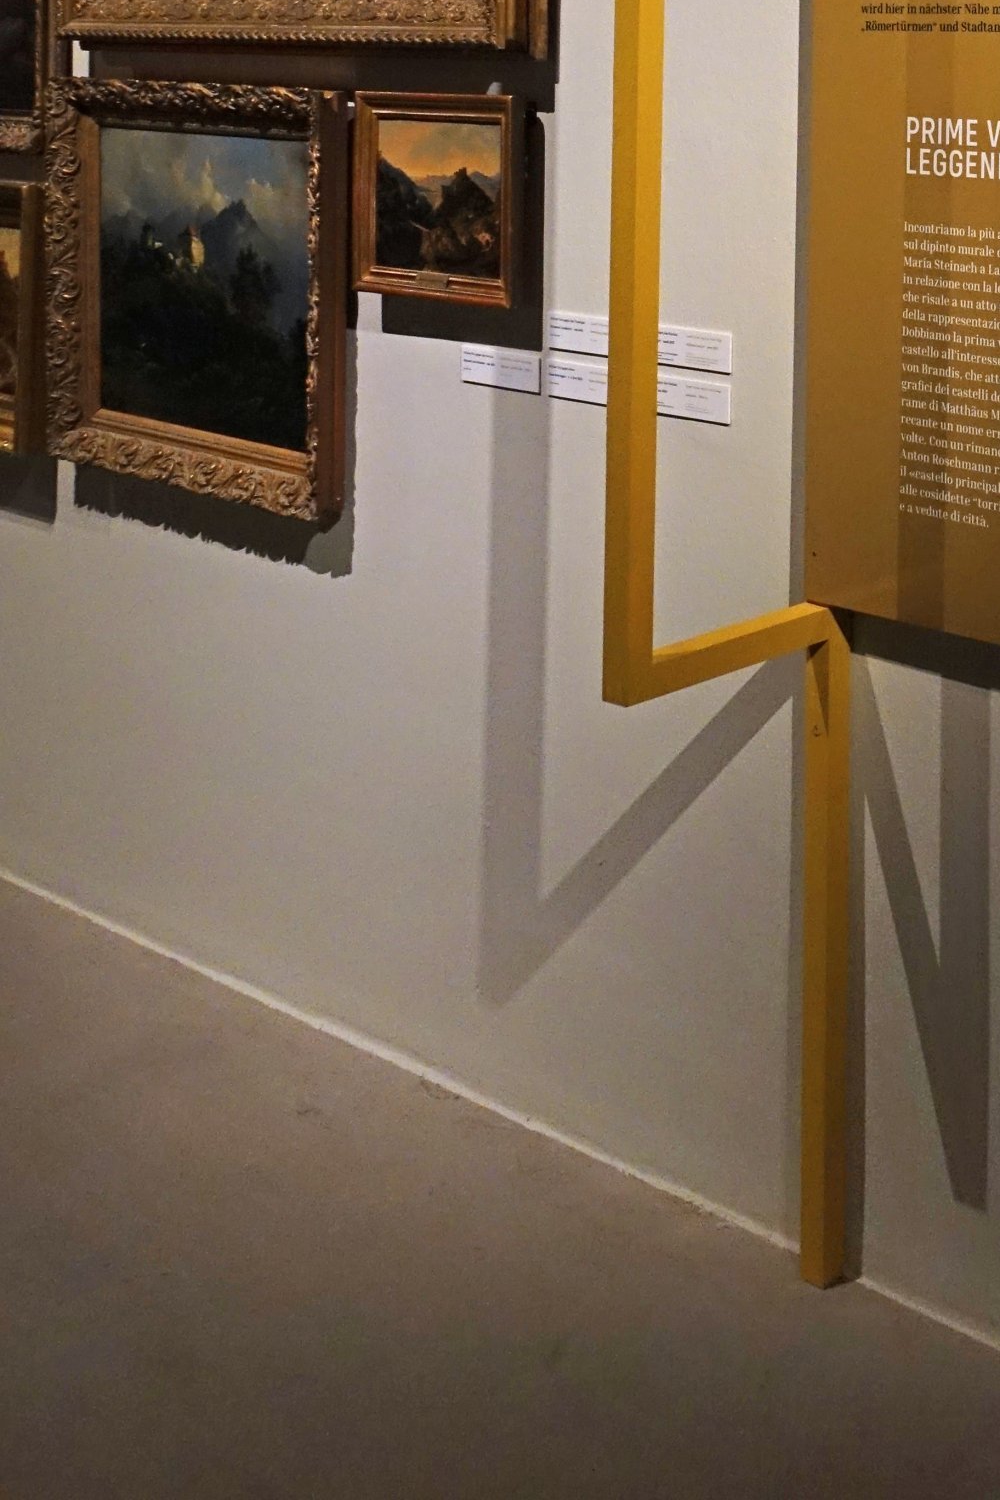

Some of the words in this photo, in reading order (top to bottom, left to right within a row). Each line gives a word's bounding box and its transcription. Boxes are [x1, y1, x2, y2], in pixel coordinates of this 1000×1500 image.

[939, 20, 959, 33] und
[906, 116, 978, 147] PRIME
[903, 220, 966, 237] Incontriamo
[966, 225, 977, 239] la
[978, 227, 996, 242] più
[903, 238, 919, 251] sul
[919, 239, 957, 255] dipinto
[957, 244, 995, 258] murale
[902, 272, 913, 285] in
[915, 274, 961, 290] relazione
[961, 281, 981, 293] con
[982, 280, 993, 294] la
[902, 307, 926, 322] della
[901, 325, 952, 342] Dobbiamo
[952, 330, 963, 344] la
[964, 333, 996, 348] prima
[901, 345, 940, 358] castello
[901, 397, 927, 410] rame
[928, 399, 939, 412] di
[941, 401, 989, 420] Matthäus
[900, 415, 939, 429] recante
[940, 421, 954, 432] un
[955, 423, 984, 437] nome
